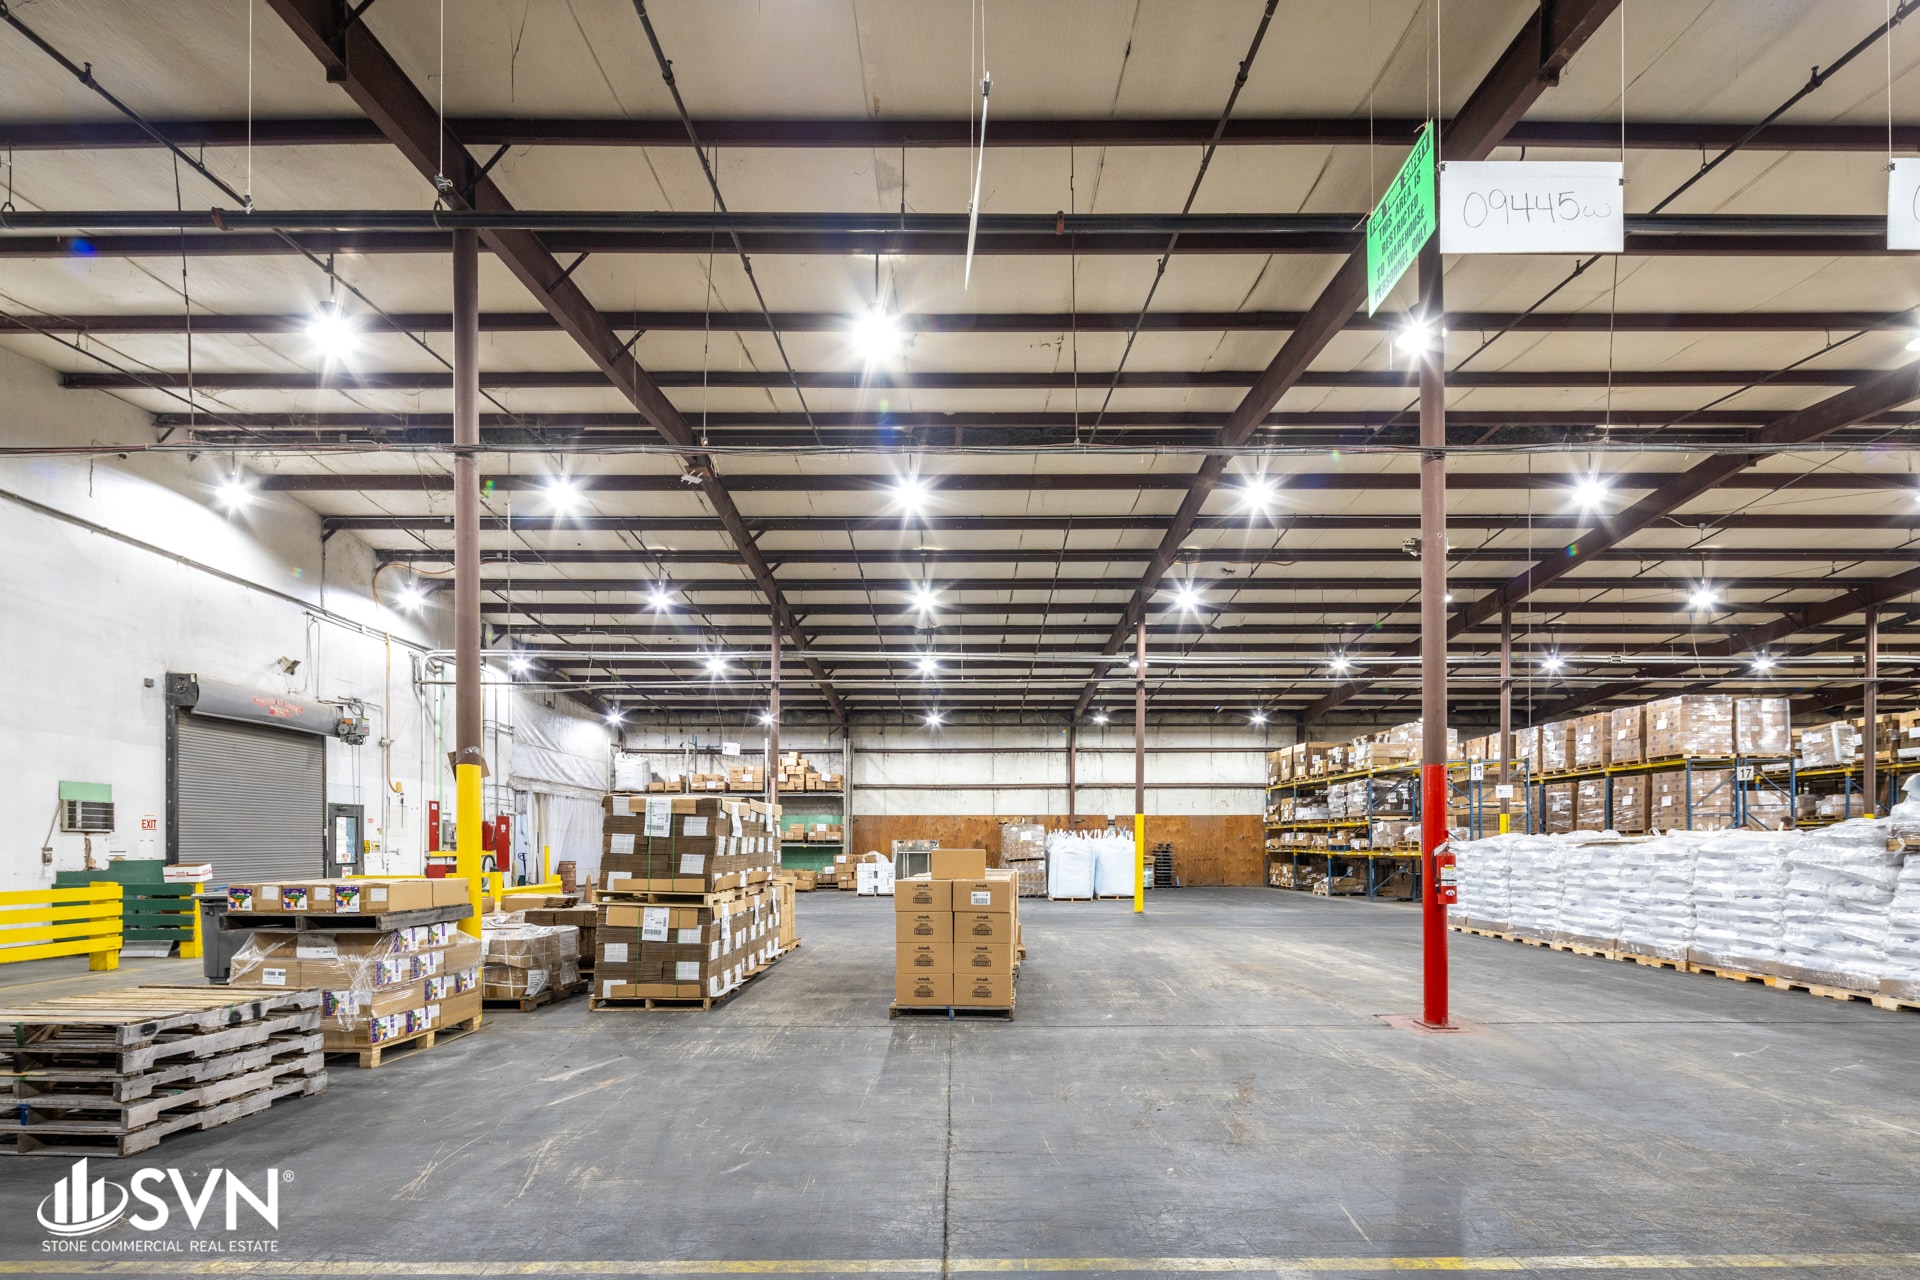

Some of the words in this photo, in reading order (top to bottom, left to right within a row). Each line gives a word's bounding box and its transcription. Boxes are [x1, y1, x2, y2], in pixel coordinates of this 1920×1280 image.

[1404, 135, 1429, 183] SAFETY
[1379, 211, 1392, 240] THIS
[1395, 184, 1411, 218] AREA
[1413, 168, 1421, 189] IS
[1381, 193, 1418, 256] RESTRICTED
[1374, 248, 1409, 304] PERSONNEL
[1411, 219, 1427, 253] ONLY
[1377, 261, 1385, 281] TO
[1387, 203, 1424, 266] WAREHOUSE
[1473, 766, 1482, 777] 19
[1740, 768, 1752, 779] 17
[142, 819, 157, 829] EXIT
